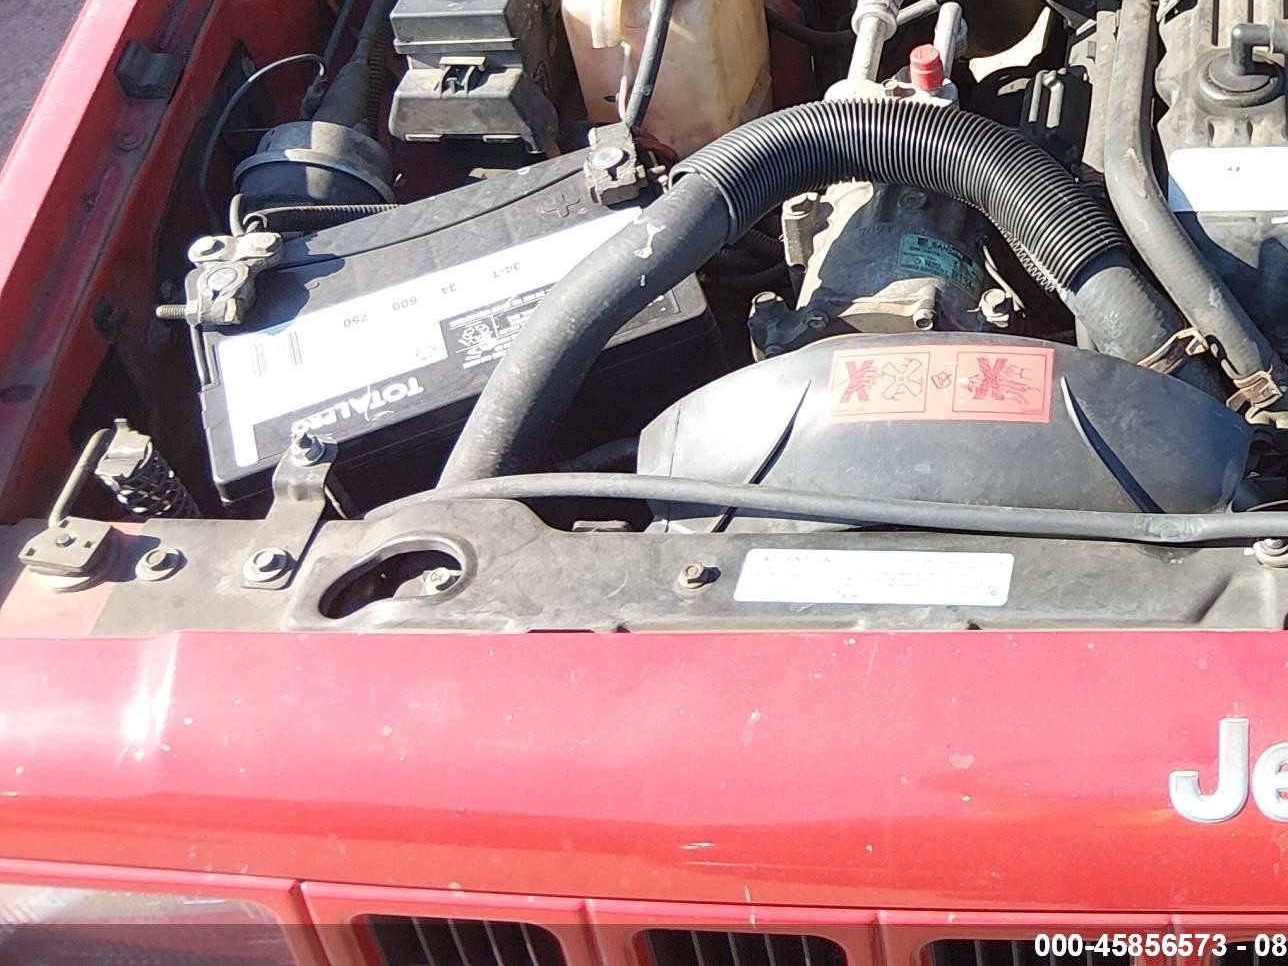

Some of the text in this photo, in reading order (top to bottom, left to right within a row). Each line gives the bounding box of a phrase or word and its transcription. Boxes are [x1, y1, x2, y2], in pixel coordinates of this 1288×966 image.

[343, 262, 521, 328] 34-T 34 600 750
[291, 376, 425, 437] TOTALPRO
